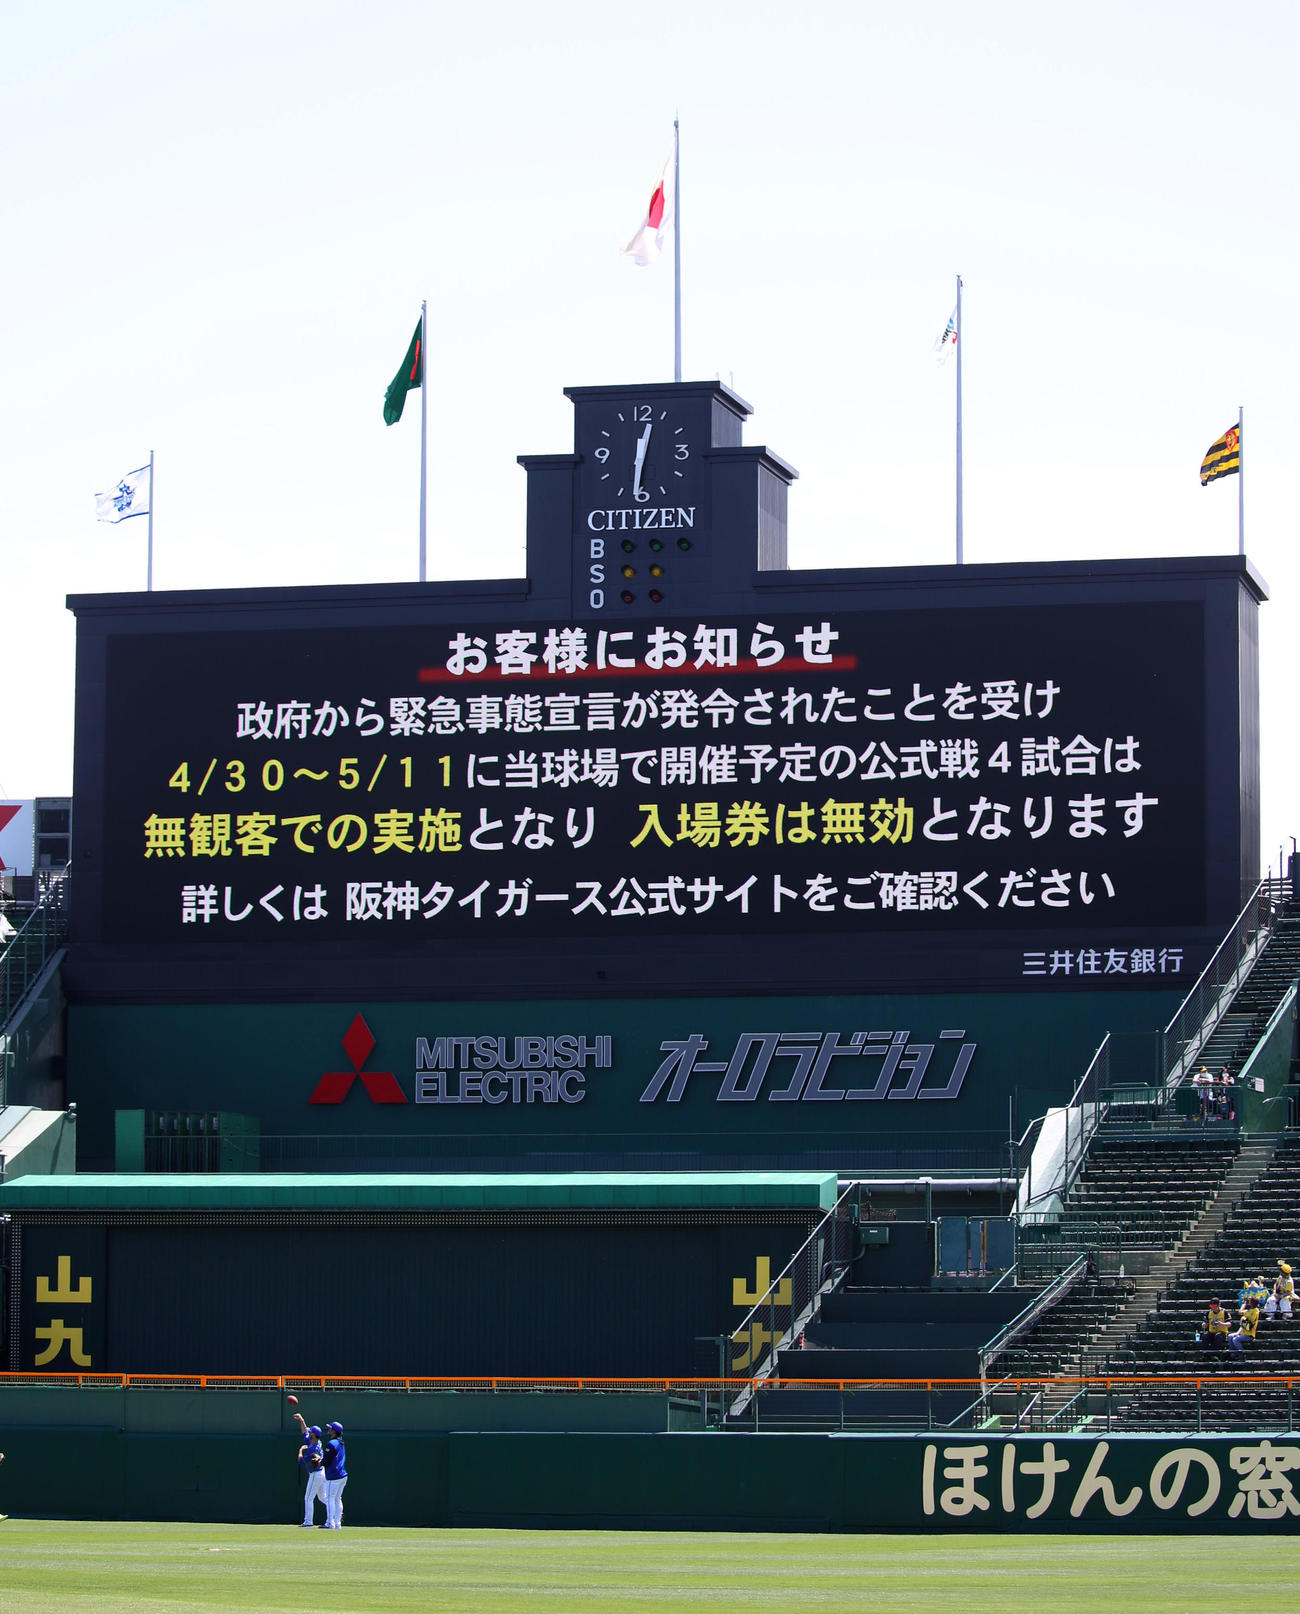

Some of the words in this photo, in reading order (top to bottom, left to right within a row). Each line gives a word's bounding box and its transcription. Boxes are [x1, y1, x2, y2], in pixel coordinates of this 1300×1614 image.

[634, 405, 652, 422] 12
[594, 447, 610, 464] 9
[674, 444, 690, 460] 3
[634, 486, 650, 503] 6
[587, 506, 696, 531] CITIZEN
[590, 538, 605, 559] B
[589, 563, 605, 584] S
[589, 588, 604, 609] O
[446, 622, 838, 675] お客様にお知らせ
[236, 680, 1061, 740] 政府から緊急事態宣言が発令されたことを受け
[143, 807, 596, 859] 無観客での実施となり
[629, 792, 1159, 848] 入場券は無効となります
[181, 883, 329, 924] 詳しくは
[346, 868, 1116, 921] 阪神タイガース公式サイトをご確認ください
[1022, 948, 1184, 975] 三井住友銀行
[415, 1035, 612, 1069] MITSUBISHI
[639, 1029, 977, 1102] オーロラビジョン
[415, 1070, 586, 1104] ELECTRIC
[34, 1255, 92, 1367] 山九
[922, 1440, 1300, 1520] ほけんの窓
